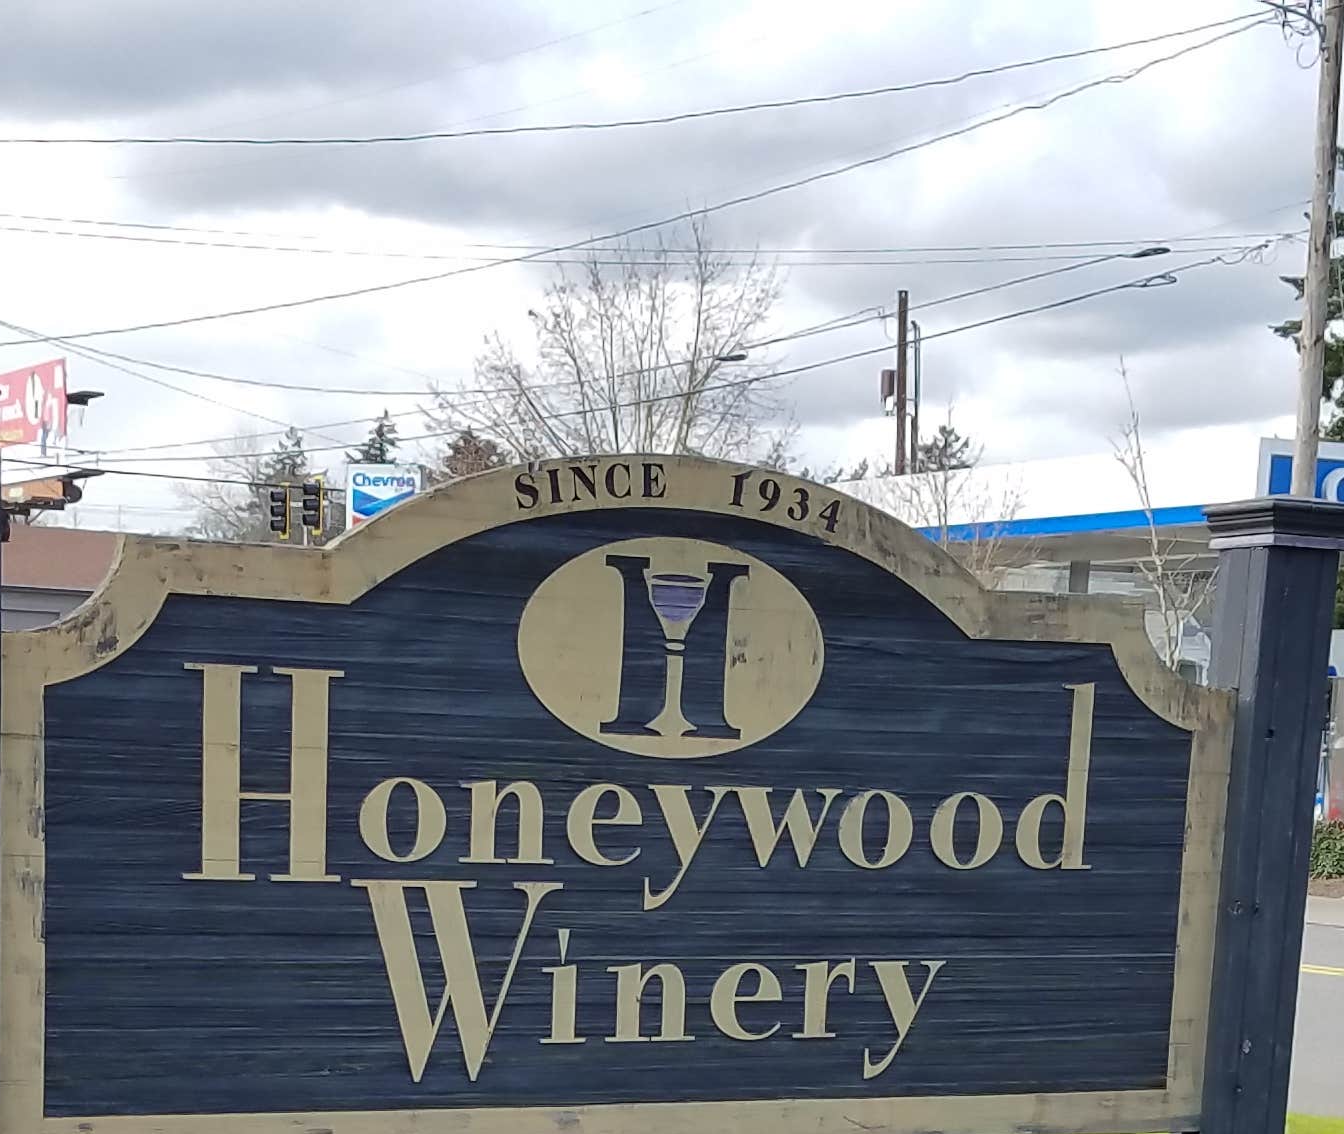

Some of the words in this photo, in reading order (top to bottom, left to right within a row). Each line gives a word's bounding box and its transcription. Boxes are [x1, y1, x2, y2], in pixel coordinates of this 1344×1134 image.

[352, 472, 416, 488] Chevron
[514, 462, 668, 510] SINCE
[728, 469, 842, 534] 1934
[181, 662, 1096, 911] Honeywood
[349, 878, 947, 1084] Winery
